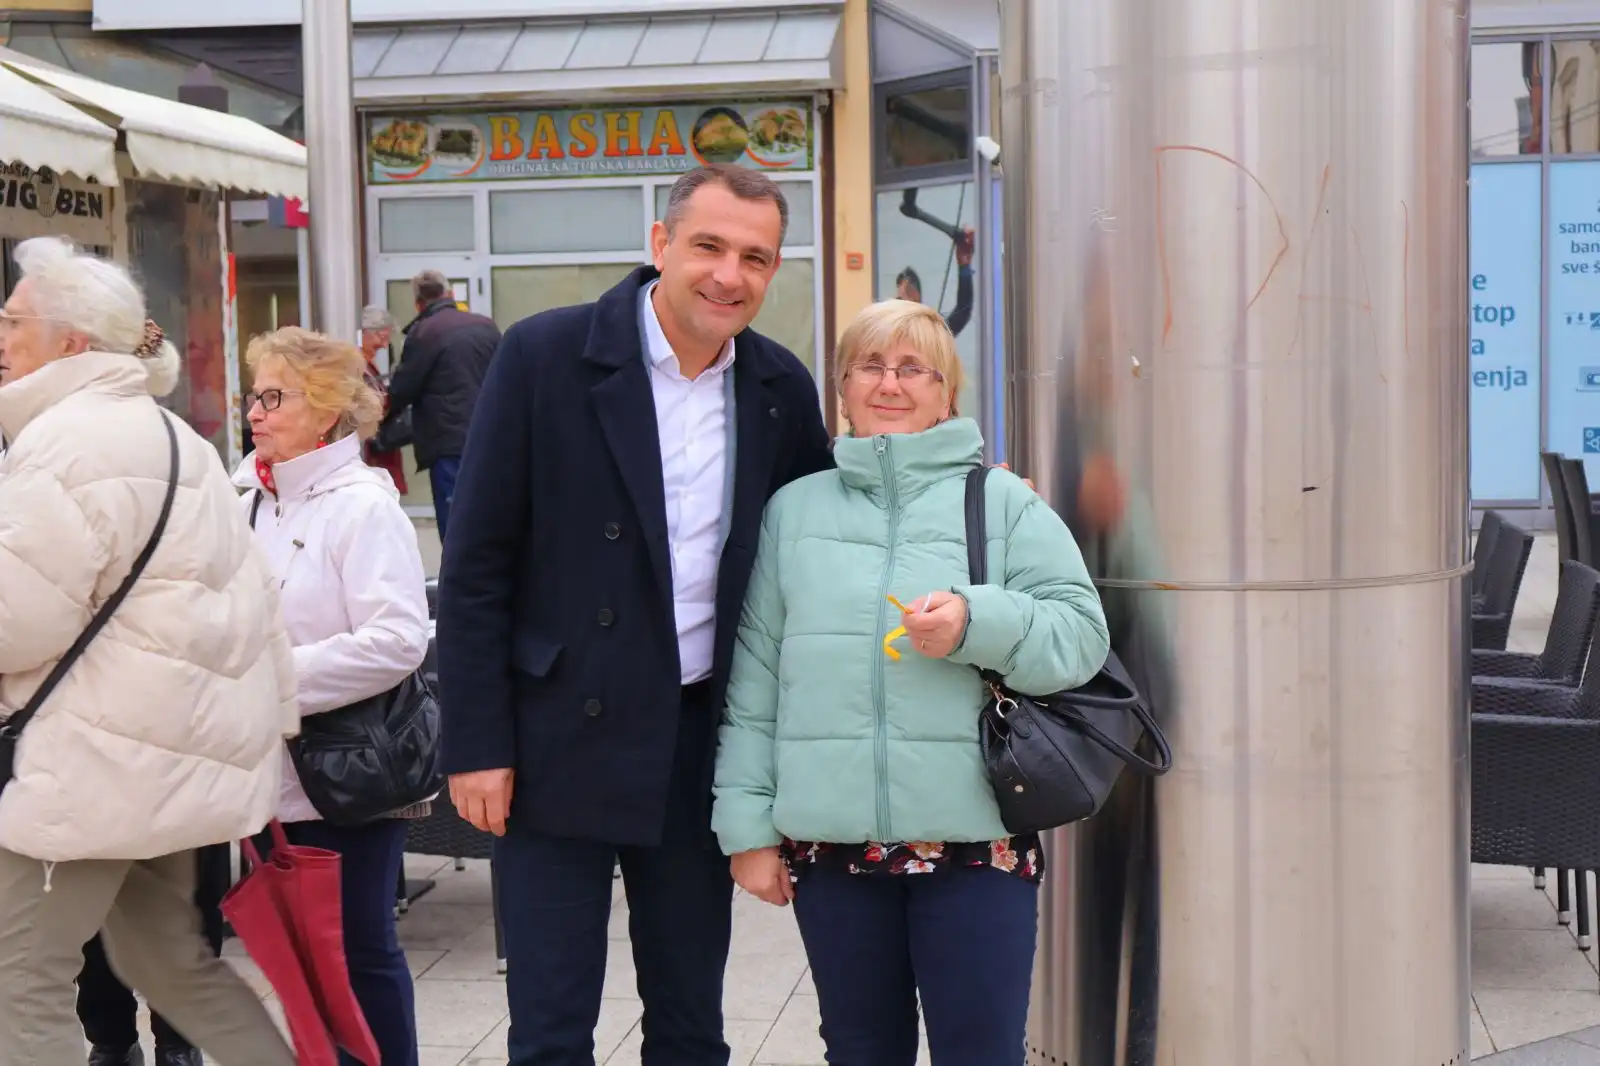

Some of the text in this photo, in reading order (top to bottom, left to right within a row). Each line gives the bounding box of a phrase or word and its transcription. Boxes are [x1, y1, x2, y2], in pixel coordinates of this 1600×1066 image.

[489, 110, 686, 160] BASHA
[0, 179, 103, 220] IG BEN
[1561, 262, 1589, 274] sve
[1472, 365, 1528, 392] enja
